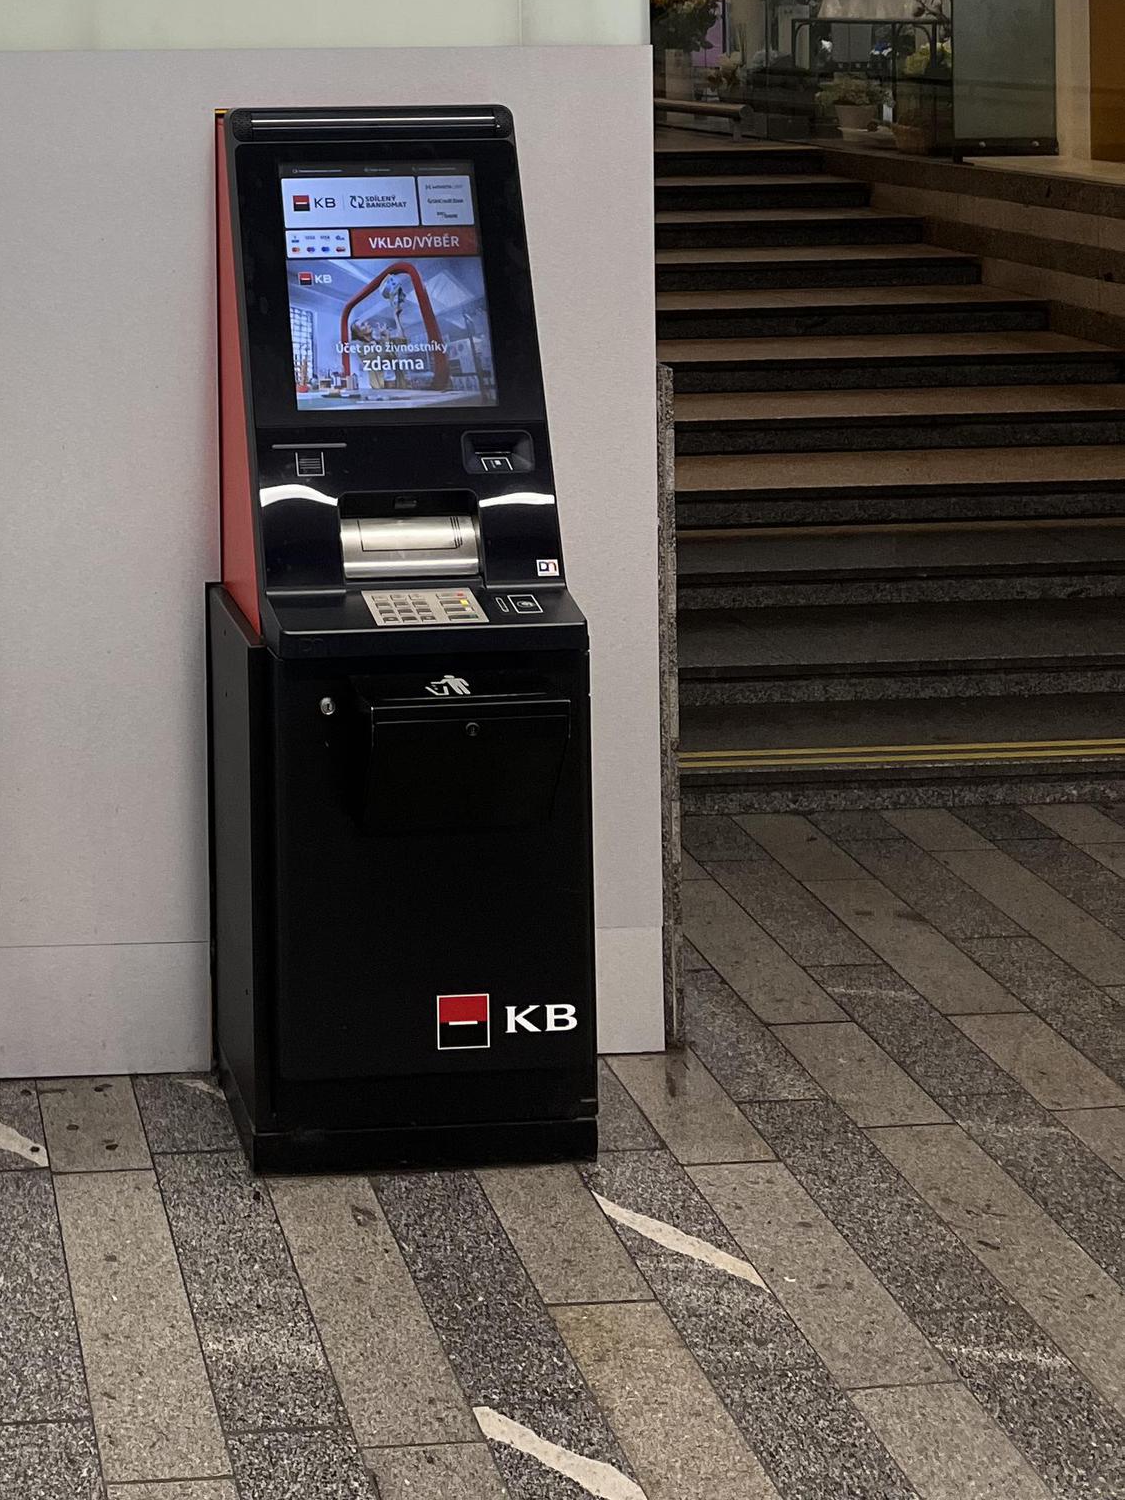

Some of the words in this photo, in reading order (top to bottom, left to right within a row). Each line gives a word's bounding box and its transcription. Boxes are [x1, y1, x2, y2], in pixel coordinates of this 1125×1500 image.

[314, 197, 336, 209] KB
[365, 201, 407, 209] BANKOMAT
[369, 234, 460, 249] VKLAD/VÝBĚR
[314, 274, 332, 284] KB
[336, 340, 361, 354] Účet
[363, 343, 383, 356] pro
[384, 339, 448, 355] živnostníky
[362, 356, 425, 371] zdarma
[504, 1004, 579, 1033] KB
